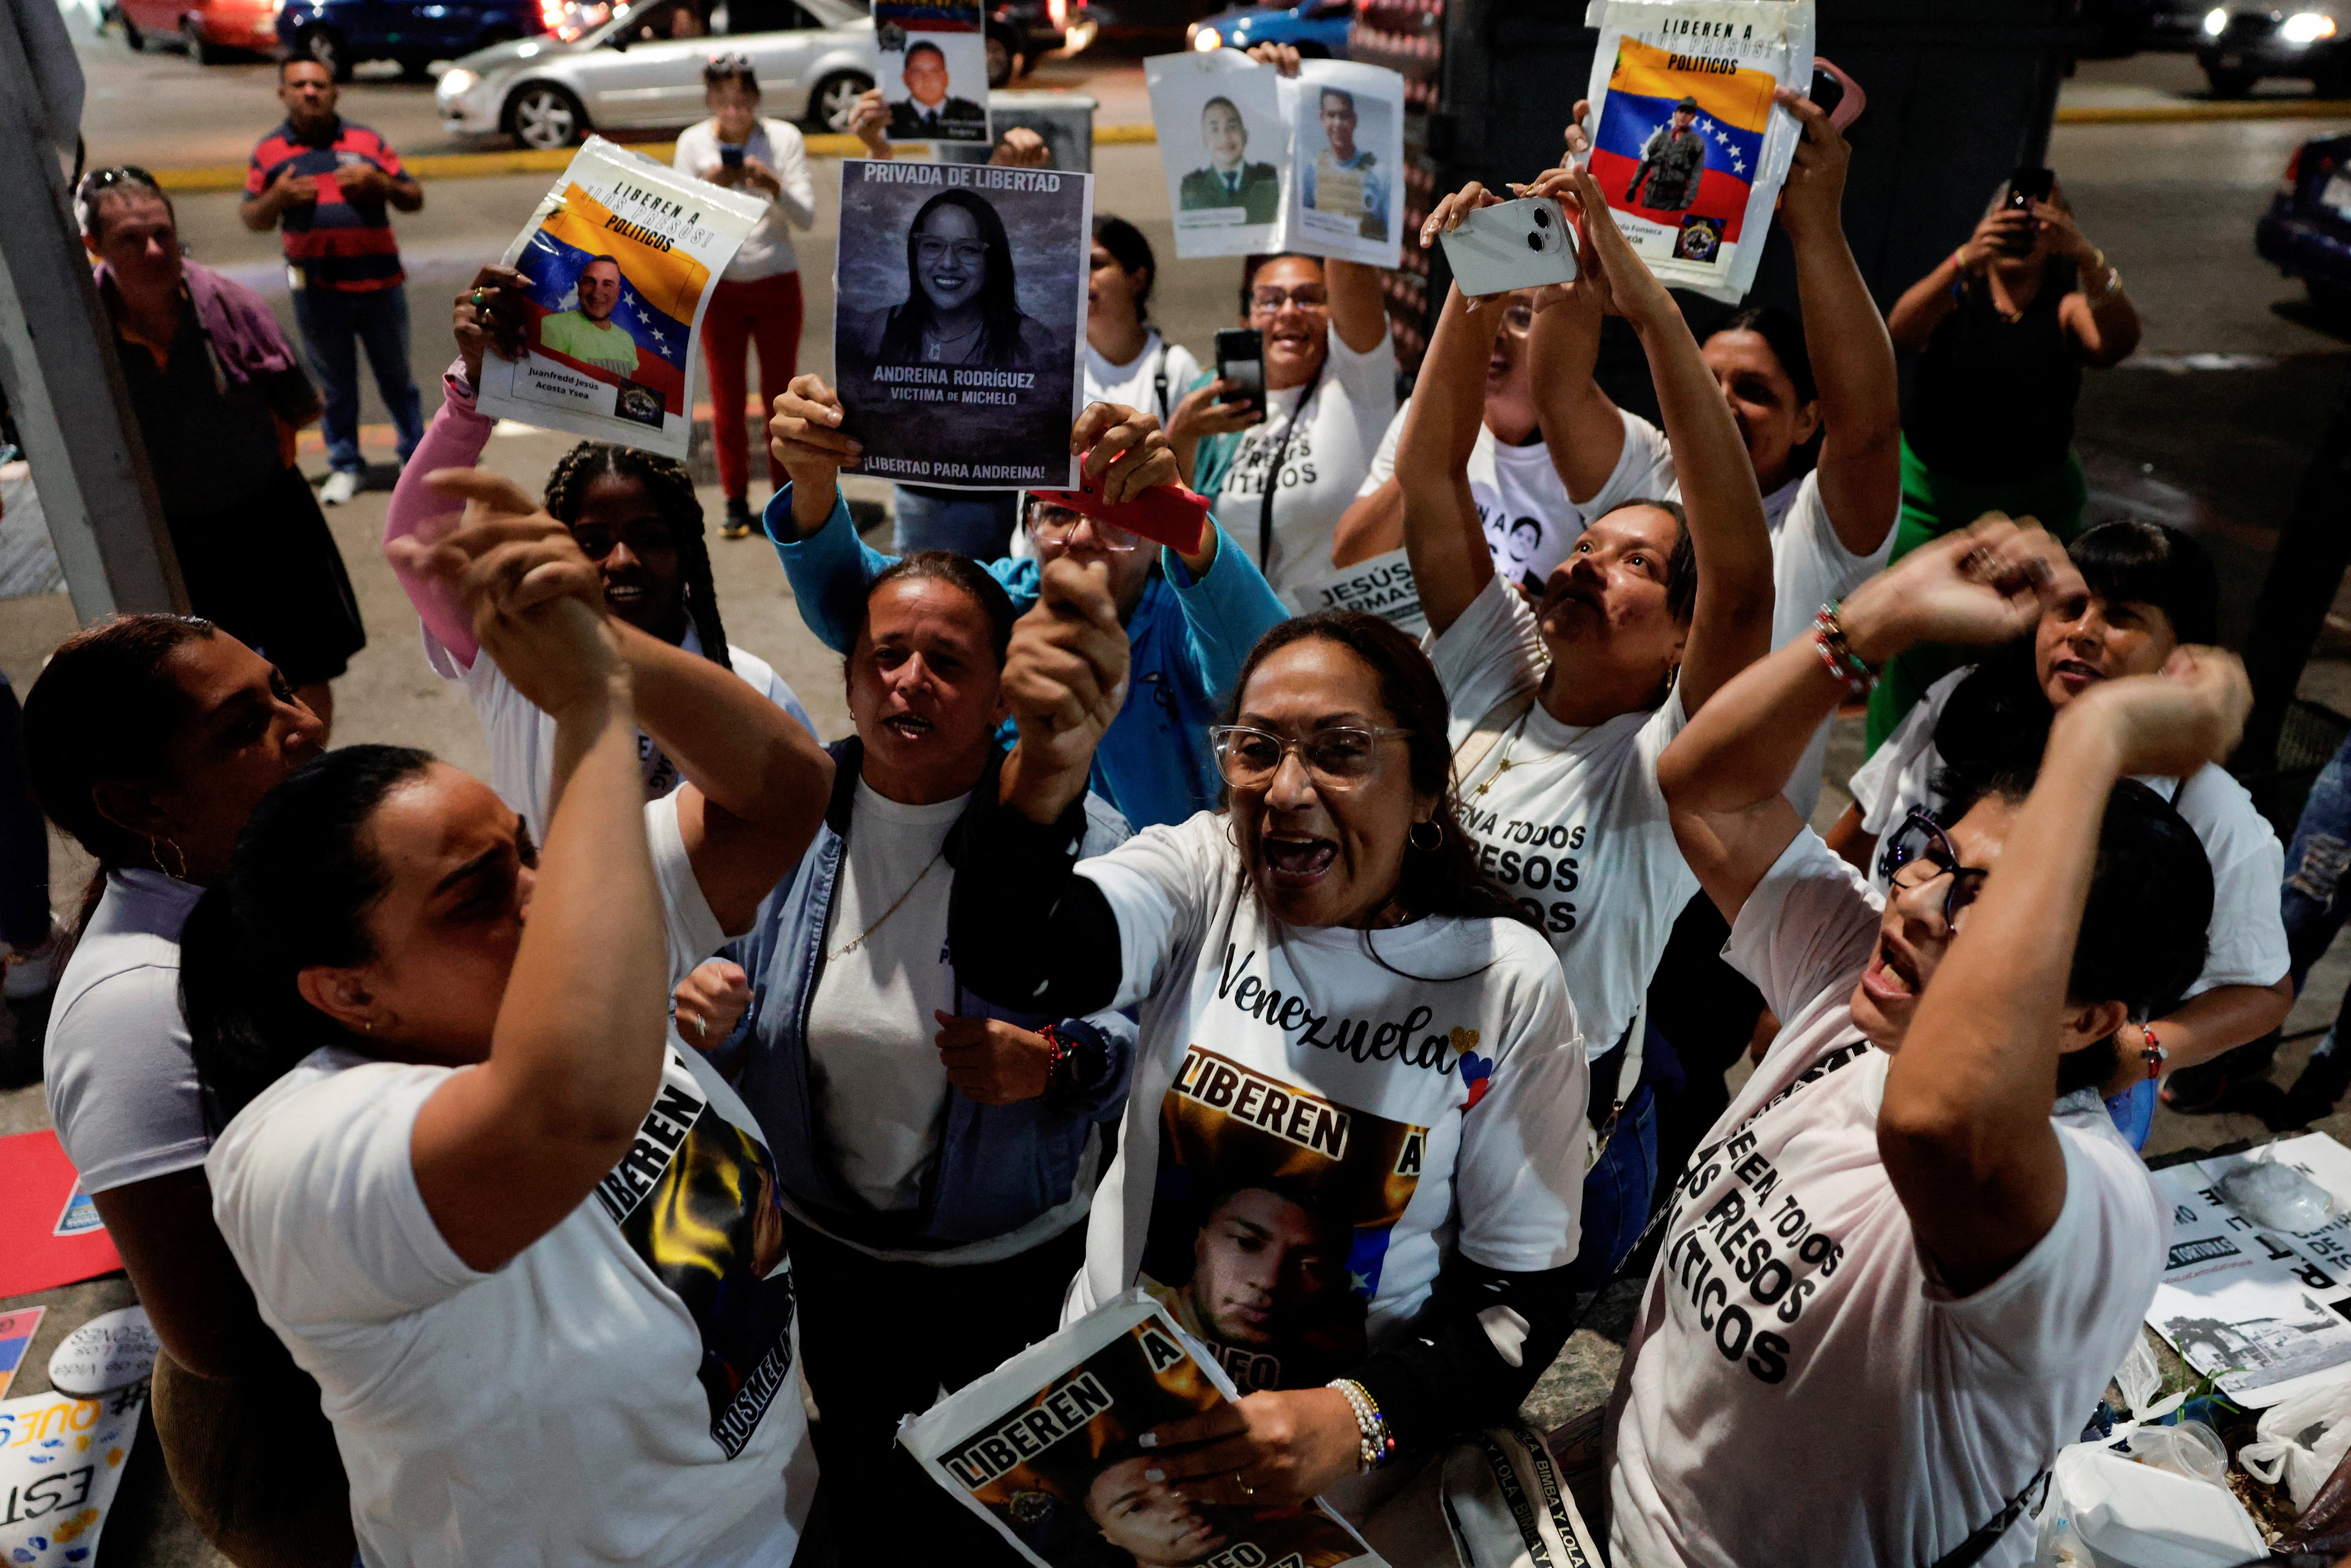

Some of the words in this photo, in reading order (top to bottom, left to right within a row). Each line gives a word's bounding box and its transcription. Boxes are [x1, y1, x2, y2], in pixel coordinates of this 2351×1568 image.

[1663, 19, 1734, 39] LIBEREN
[1744, 24, 1753, 39] A
[864, 163, 942, 185] PRIVADA
[947, 166, 970, 187] DE
[975, 167, 1061, 193] LIBERTAD
[613, 181, 684, 219] LIBEREN
[687, 212, 701, 226] A
[1632, 225, 1662, 236] Fonseca
[536, 380, 566, 394] Acosta
[569, 388, 589, 400] Ysea
[873, 365, 948, 385] ANDREINA
[953, 368, 1035, 389] RODRÍGUEZ
[890, 386, 944, 402] VICTIMA
[947, 392, 959, 402] DE
[962, 391, 1017, 406] MICHELO
[864, 456, 931, 475] ¡LIBERTAD
[933, 462, 969, 478] PARA
[971, 464, 1045, 479] ANDREINA!
[1320, 562, 1412, 607] JESÚS
[1479, 812, 1498, 835] A
[1502, 820, 1586, 850] TODOS
[1218, 942, 1457, 1075] Venezuela
[1172, 1051, 1350, 1160] LIBEREN
[1397, 1132, 1422, 1174] A
[595, 1083, 704, 1223] IBEREN
[1704, 1187, 1817, 1324] PRESOS
[1769, 1193, 1845, 1278] TODOS
[1141, 1331, 1183, 1371] A
[711, 1347, 785, 1457] ROSMEL
[947, 1373, 1112, 1489] LIBEREN
[1493, 1456, 1520, 1499] LOLA
[1513, 1502, 1542, 1552] BIMBA
[1536, 1459, 1560, 1508] BIMBA
[1553, 1510, 1566, 1521] Y
[1558, 1526, 1585, 1568] LOLA
